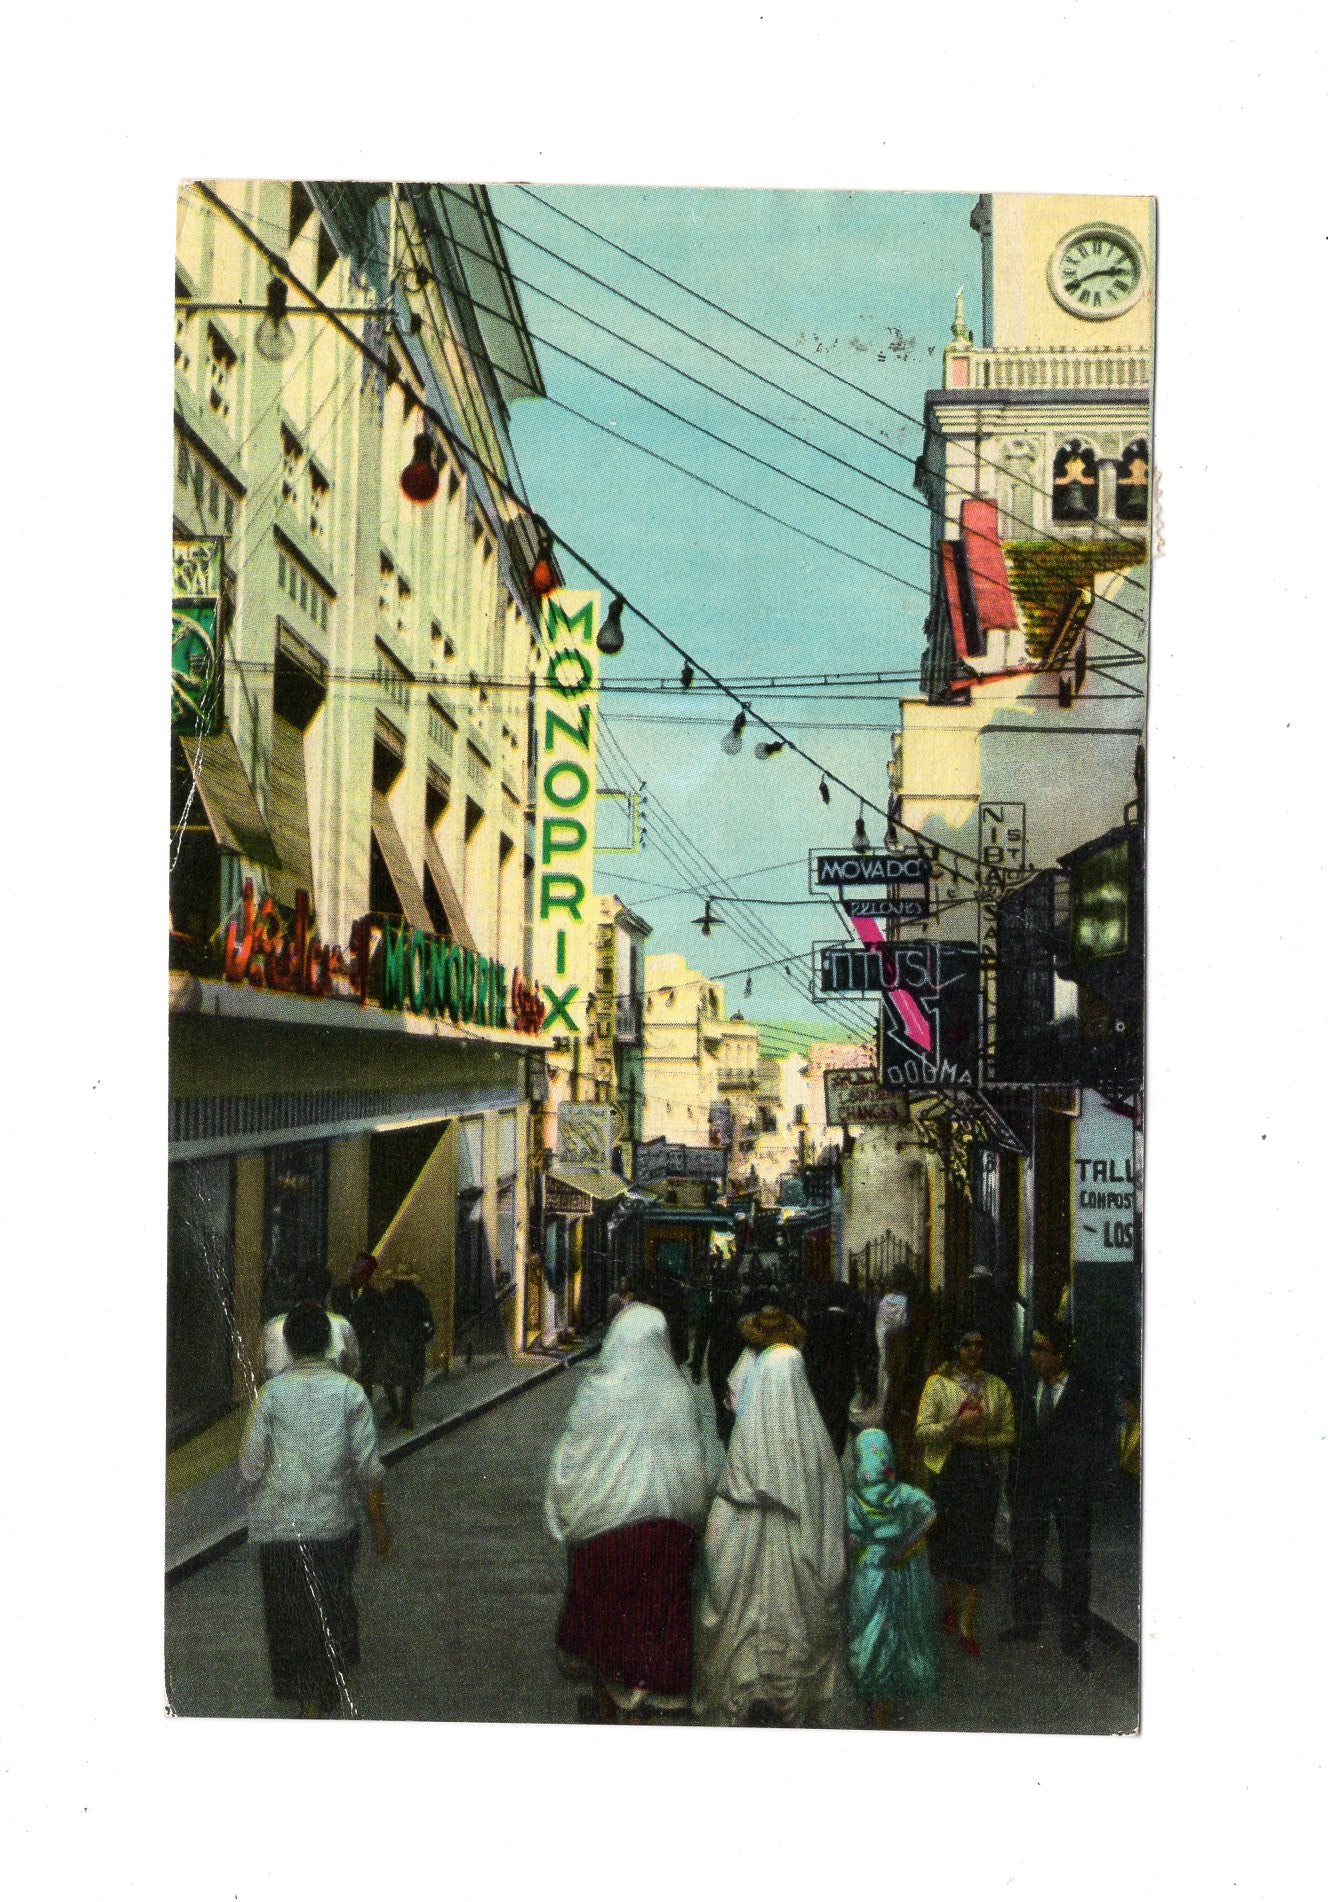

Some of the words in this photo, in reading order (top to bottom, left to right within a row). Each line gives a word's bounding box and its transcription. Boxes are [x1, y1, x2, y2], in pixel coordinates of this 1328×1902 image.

[539, 599, 594, 1033] MONOPRIX
[821, 859, 922, 880] MOVADO
[826, 950, 926, 988] TITUS
